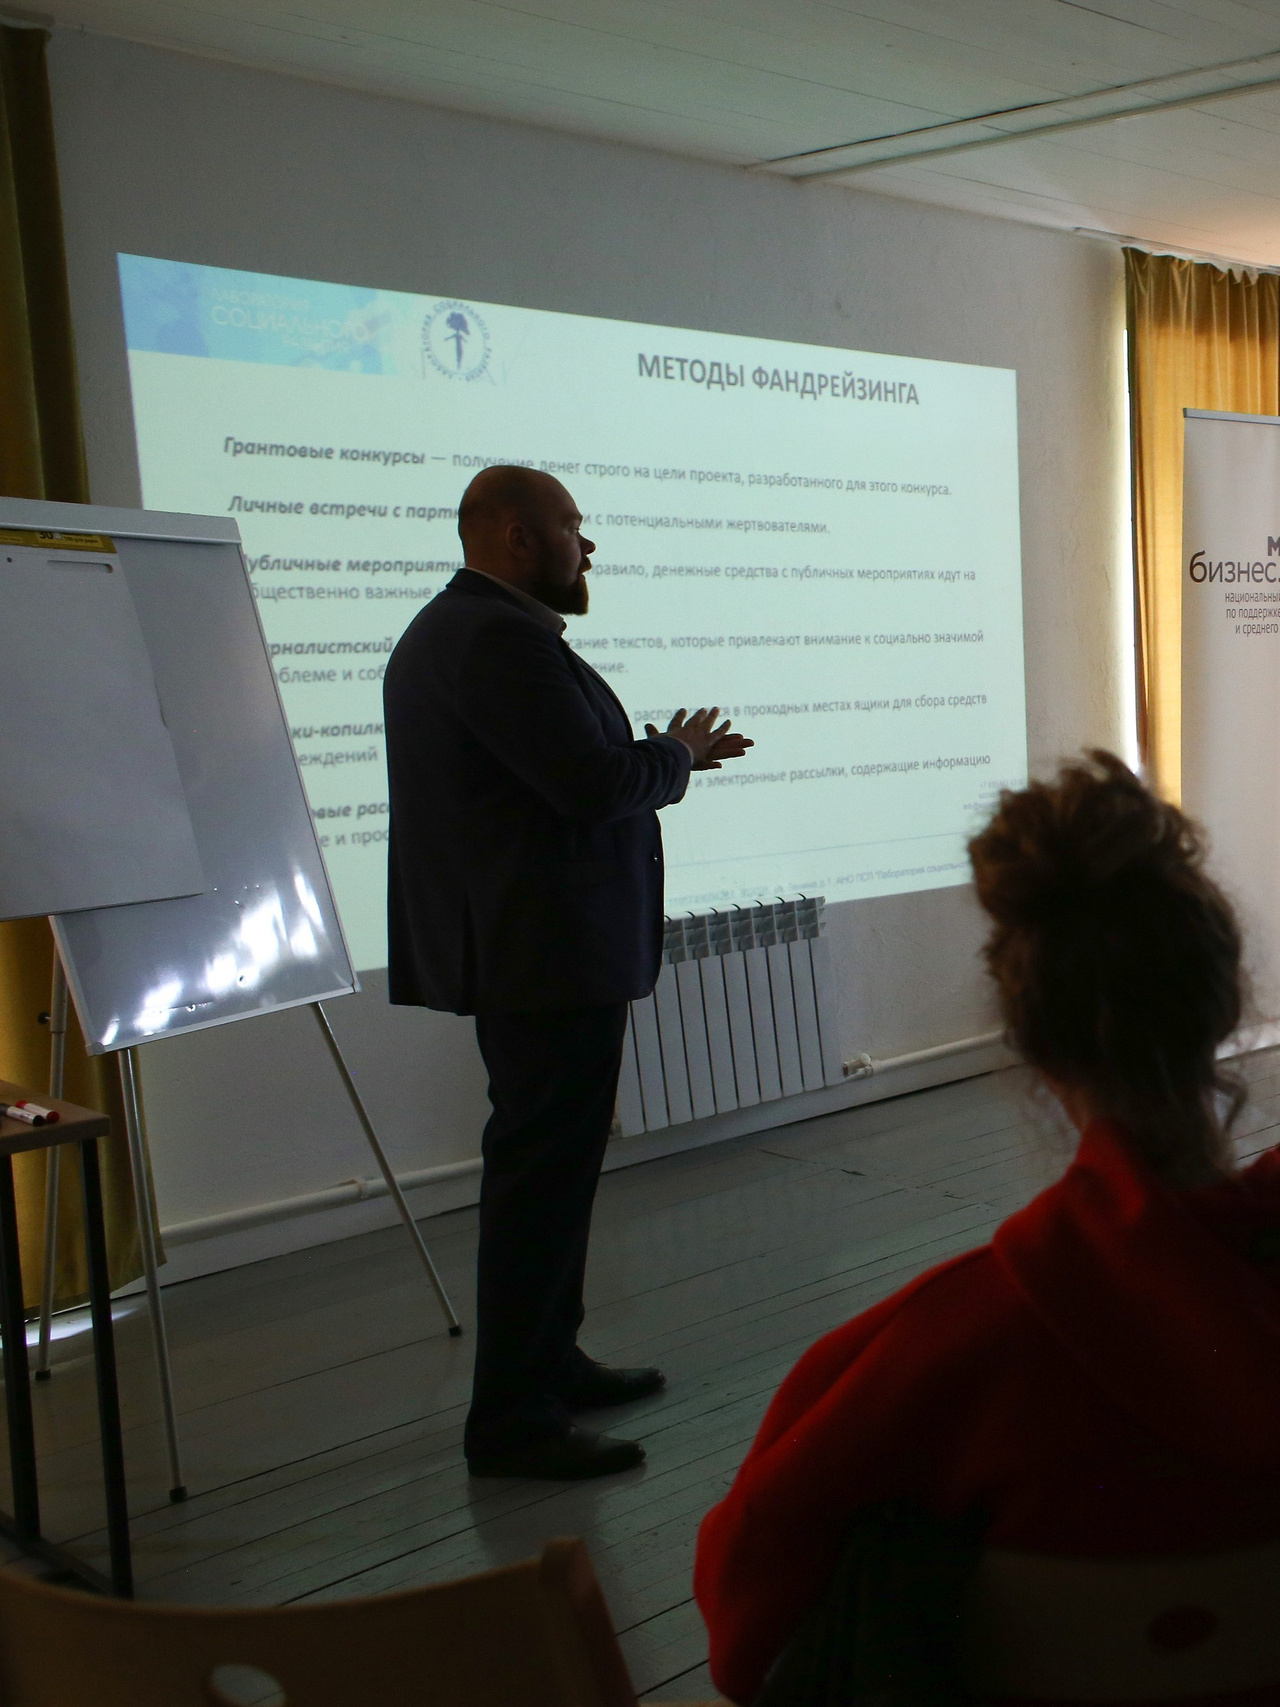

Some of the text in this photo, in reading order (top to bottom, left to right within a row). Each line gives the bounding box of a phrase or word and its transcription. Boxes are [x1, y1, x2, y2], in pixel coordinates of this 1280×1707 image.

[638, 353, 919, 405] МЕТОДЫ ФАНДРЕЙЗИНГА
[224, 436, 334, 460] Грантовые
[339, 447, 425, 466] конкурсы
[539, 460, 581, 475] денег
[584, 463, 630, 479] строго
[634, 467, 650, 479] на
[654, 468, 686, 482] цели
[690, 469, 745, 486] проекта,
[748, 473, 843, 491] разработанного
[845, 480, 867, 493] для
[869, 480, 898, 493] этого
[901, 483, 952, 497] конкурса.
[228, 495, 304, 515] Личные
[309, 501, 387, 520] встречи
[393, 506, 401, 517] с
[596, 513, 603, 525] с
[606, 513, 722, 530] потенциальными
[726, 518, 830, 534] жертвователями.
[346, 559, 465, 576] мероприяти
[652, 565, 720, 579] денежные
[725, 566, 779, 580] средства
[782, 568, 788, 578] с
[791, 565, 854, 581] публичных
[857, 568, 935, 582] мероприятиях
[938, 569, 960, 583] идут
[964, 570, 976, 581] на
[251, 582, 431, 603] бщественно важные
[1226, 608, 1236, 619] по
[1236, 624, 1240, 634] и
[1243, 623, 1278, 637] среднего
[268, 629, 984, 658] рналистский сание текстов, которые привлекают внимание к социально значимой
[278, 666, 336, 684] блеме
[343, 669, 353, 681] и
[291, 723, 383, 738] ки-копилк
[734, 707, 740, 717] в
[744, 703, 809, 717] проходных
[813, 700, 850, 713] местах
[854, 699, 890, 712] ящики
[892, 698, 912, 712] для
[915, 695, 945, 710] сбора
[948, 693, 987, 708] средств
[298, 746, 378, 768] еждений
[695, 777, 702, 788] и
[707, 771, 786, 789] электронные
[790, 767, 848, 784] рассылки,
[851, 761, 919, 780] содержащие
[922, 753, 991, 771] информацию
[335, 833, 346, 846] и
